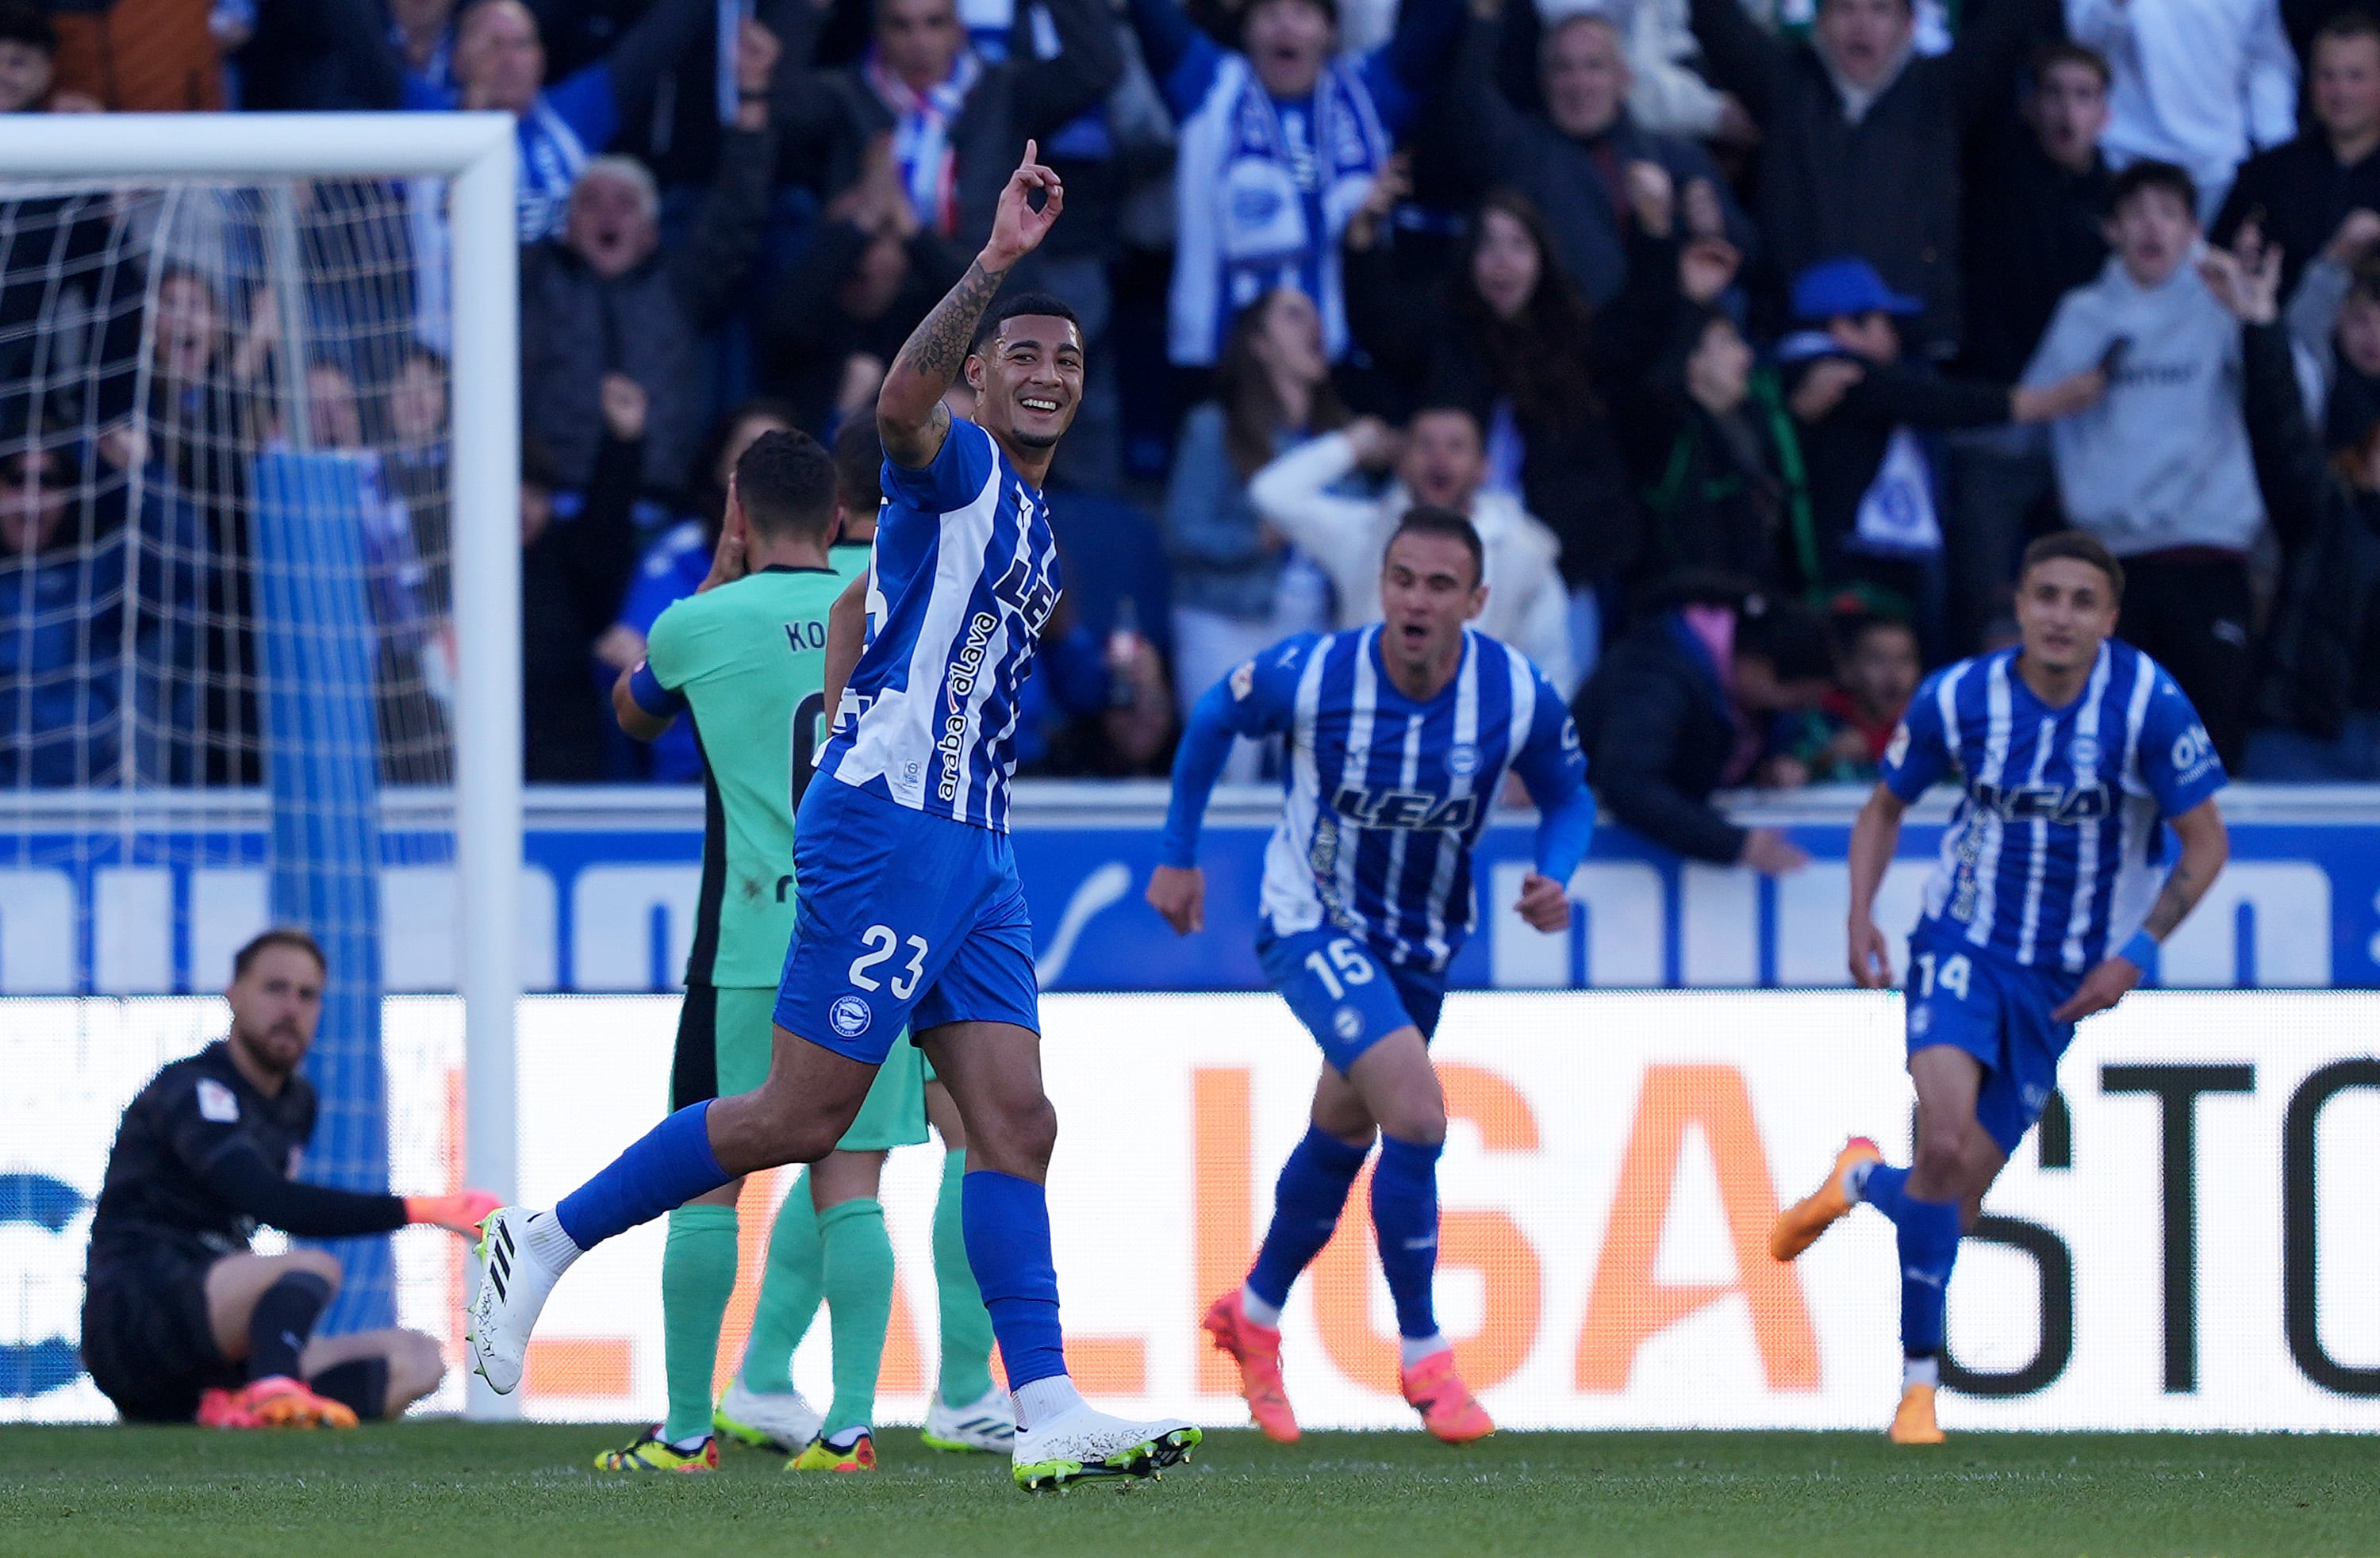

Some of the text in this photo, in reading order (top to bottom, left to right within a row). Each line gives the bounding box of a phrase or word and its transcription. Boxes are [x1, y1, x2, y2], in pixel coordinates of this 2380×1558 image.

[992, 558, 1061, 639] LE
[938, 611, 998, 802] araba álava
[1333, 788, 1478, 831] LEA
[849, 924, 928, 1000] 23
[1305, 938, 1374, 999] 15
[1917, 953, 1971, 1000] 14
